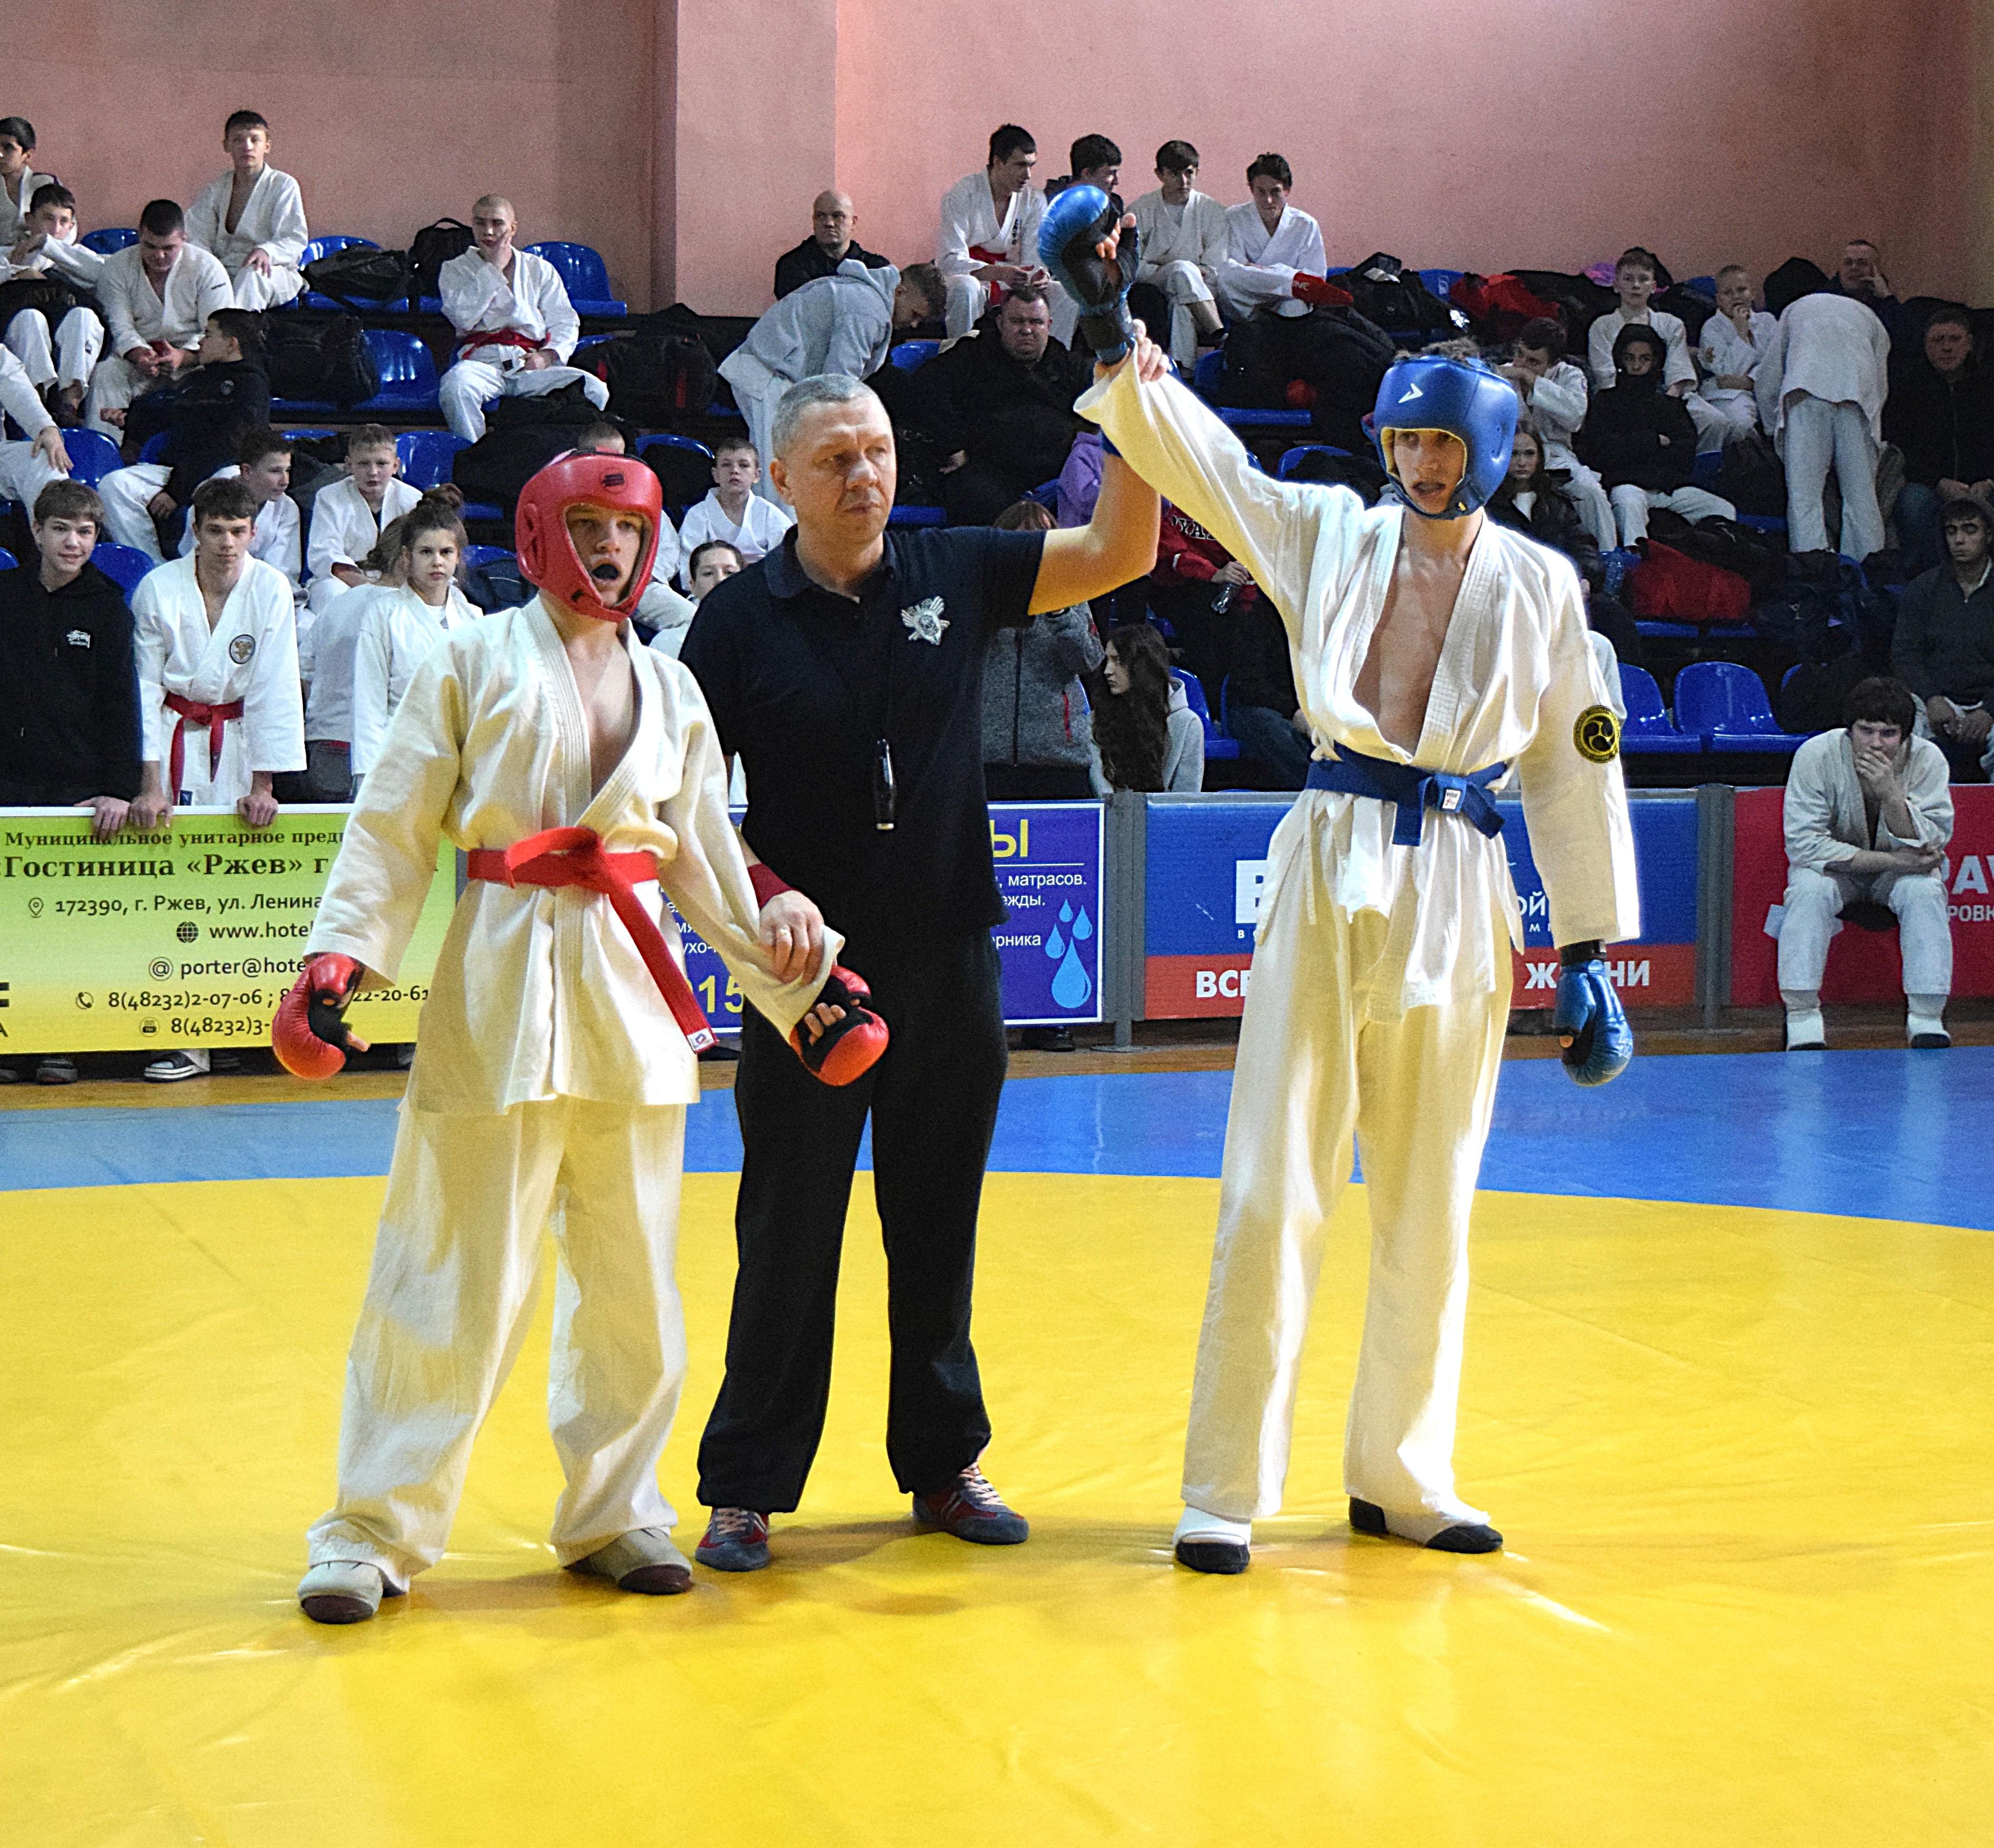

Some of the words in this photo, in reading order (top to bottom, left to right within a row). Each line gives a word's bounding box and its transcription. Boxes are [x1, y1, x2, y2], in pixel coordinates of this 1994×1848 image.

[180, 832, 285, 847] унитарное
[187, 853, 303, 875] «Ржев»
[1009, 874, 1087, 889] матрасов.
[55, 899, 128, 916] 172390,
[135, 899, 147, 911] г.
[155, 895, 211, 914] Ржев,
[218, 897, 245, 914] ул.
[992, 934, 1041, 950] рника
[1524, 960, 1650, 989] ЖНИ
[108, 990, 262, 1011] 8(48232)2-07-06
